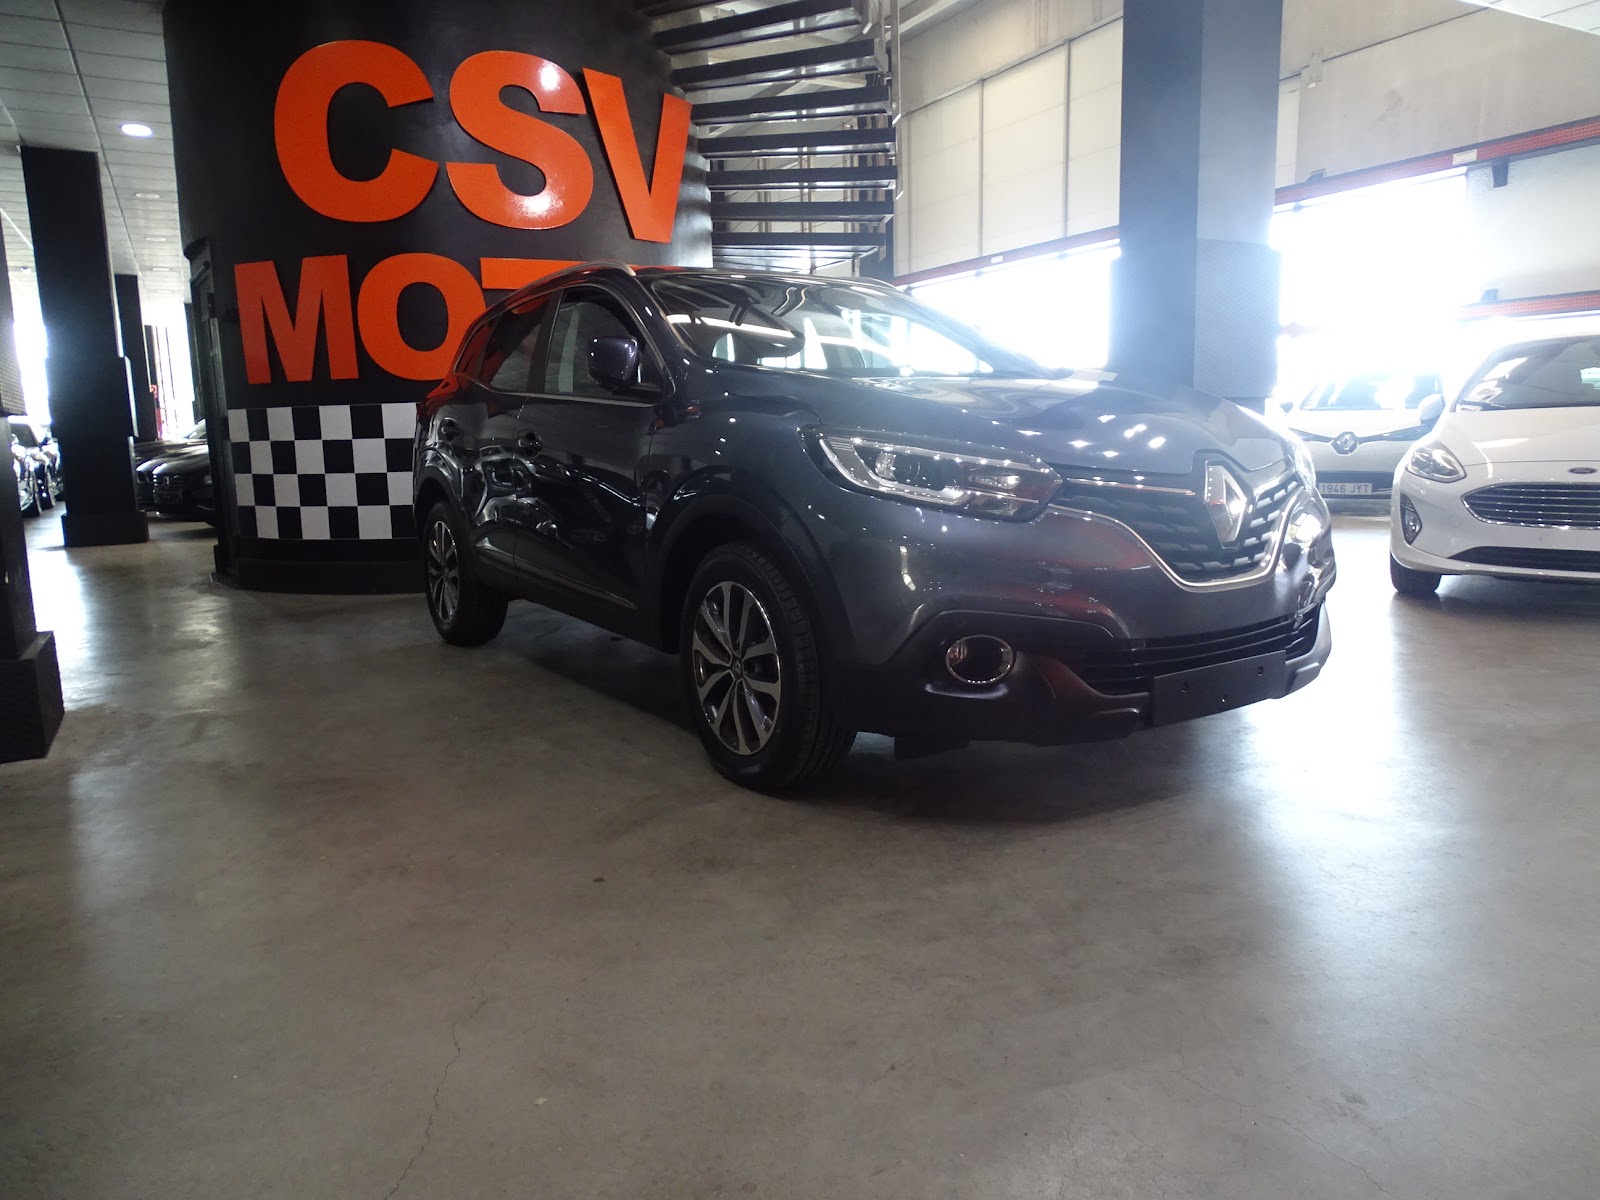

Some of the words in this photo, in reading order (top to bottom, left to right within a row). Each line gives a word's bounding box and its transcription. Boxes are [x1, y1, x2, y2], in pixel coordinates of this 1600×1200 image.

[274, 39, 693, 244] CSV
[1321, 484, 1346, 493] 1946
[1350, 484, 1370, 494] JYT
